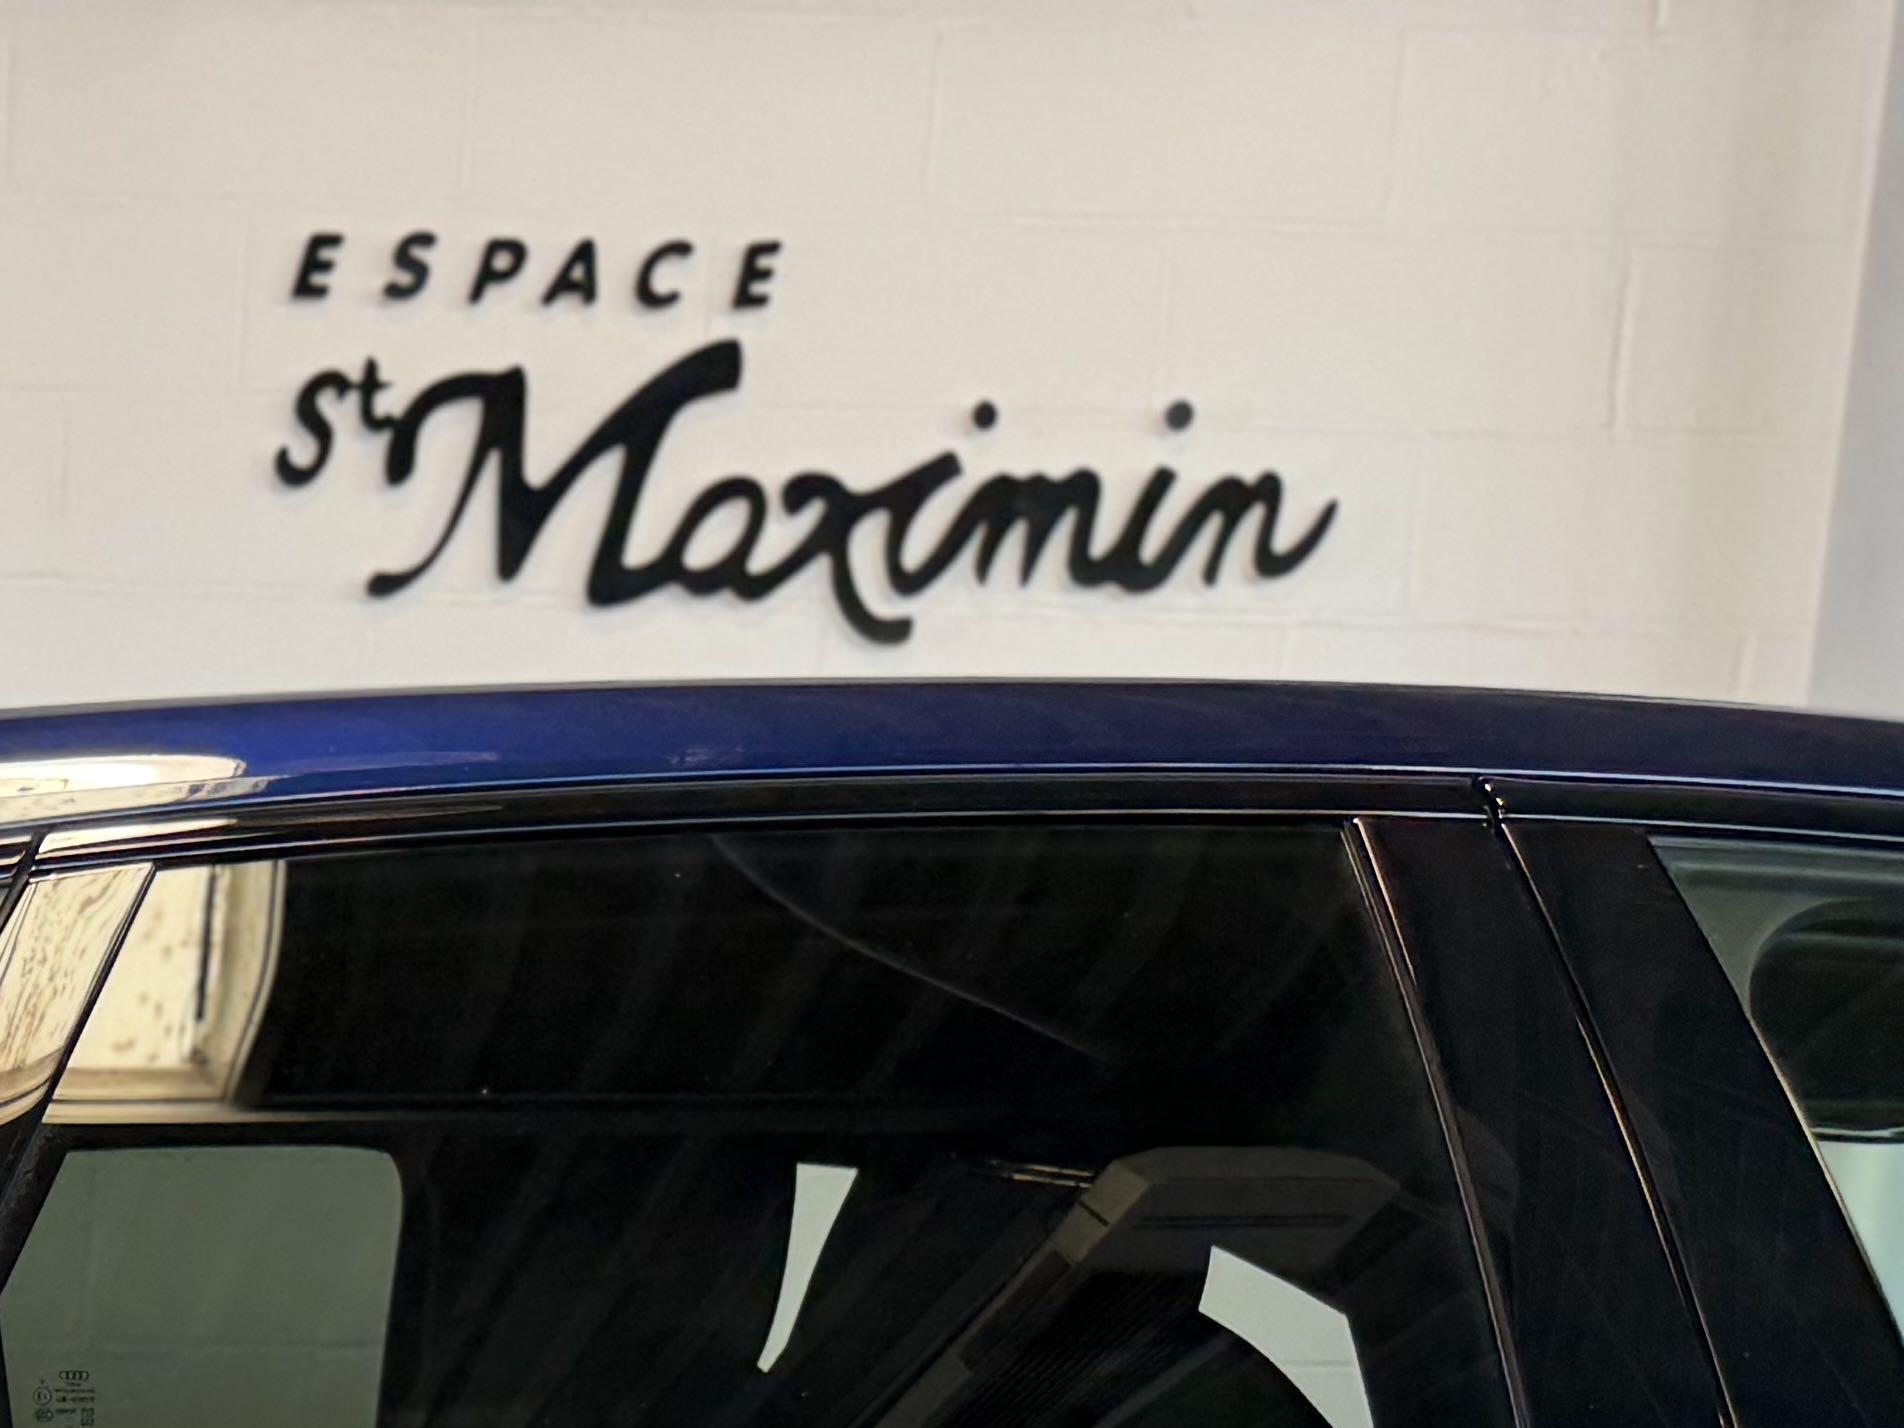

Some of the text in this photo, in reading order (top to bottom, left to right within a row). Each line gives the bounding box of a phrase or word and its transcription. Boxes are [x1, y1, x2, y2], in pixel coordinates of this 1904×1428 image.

[291, 232, 782, 310] ESPACE
[274, 339, 1337, 645] St Maximin
